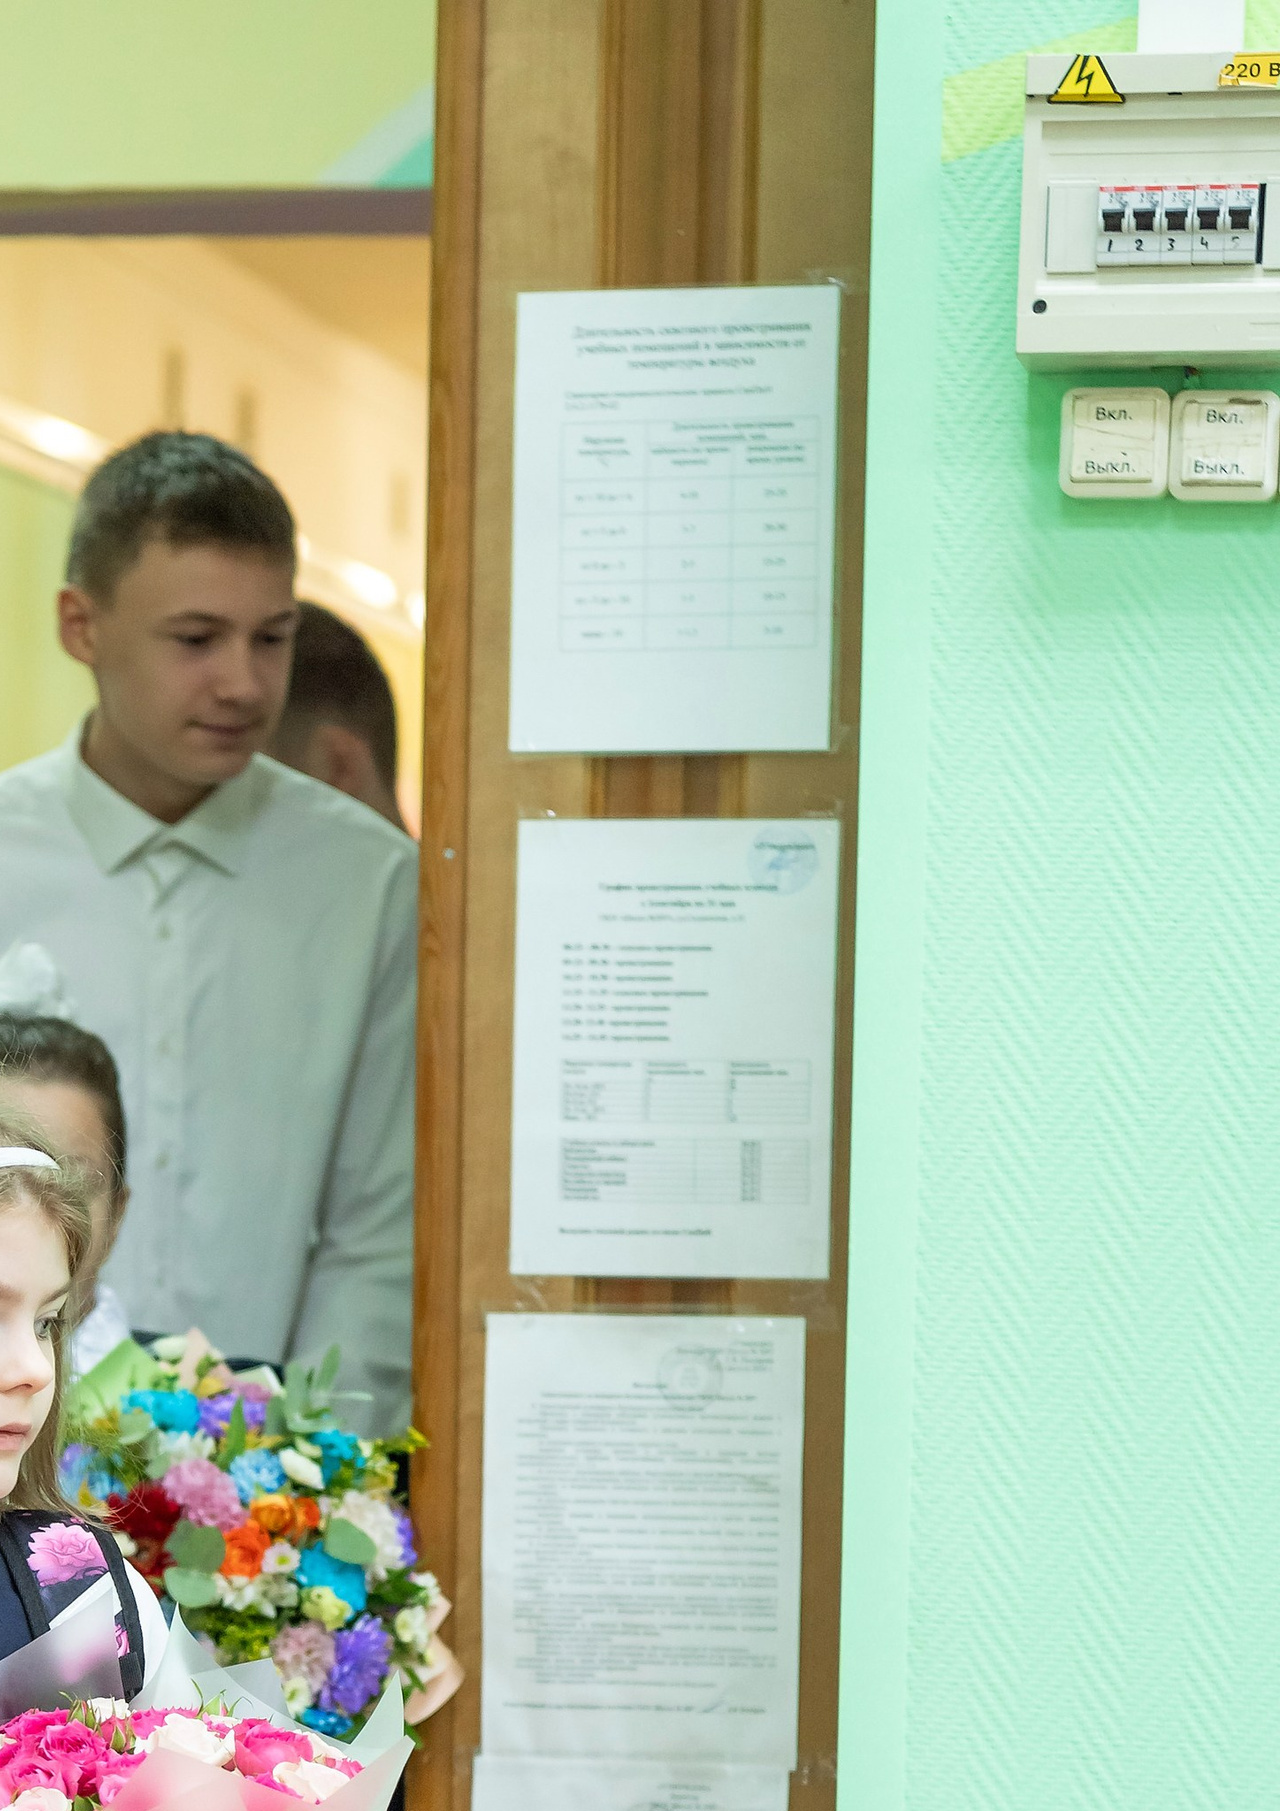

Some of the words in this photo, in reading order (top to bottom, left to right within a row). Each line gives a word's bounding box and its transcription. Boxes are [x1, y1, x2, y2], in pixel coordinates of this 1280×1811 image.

[1224, 62, 1261, 78] 220
[1107, 239, 1113, 252] 1
[1135, 238, 1144, 251] 2
[1167, 238, 1176, 251] 3
[1200, 236, 1209, 250] 4
[1095, 406, 1132, 421] Вкл.
[1206, 409, 1244, 424] Вкл.
[1085, 460, 1136, 475] Выкл.
[1194, 459, 1245, 475] Выкл.
